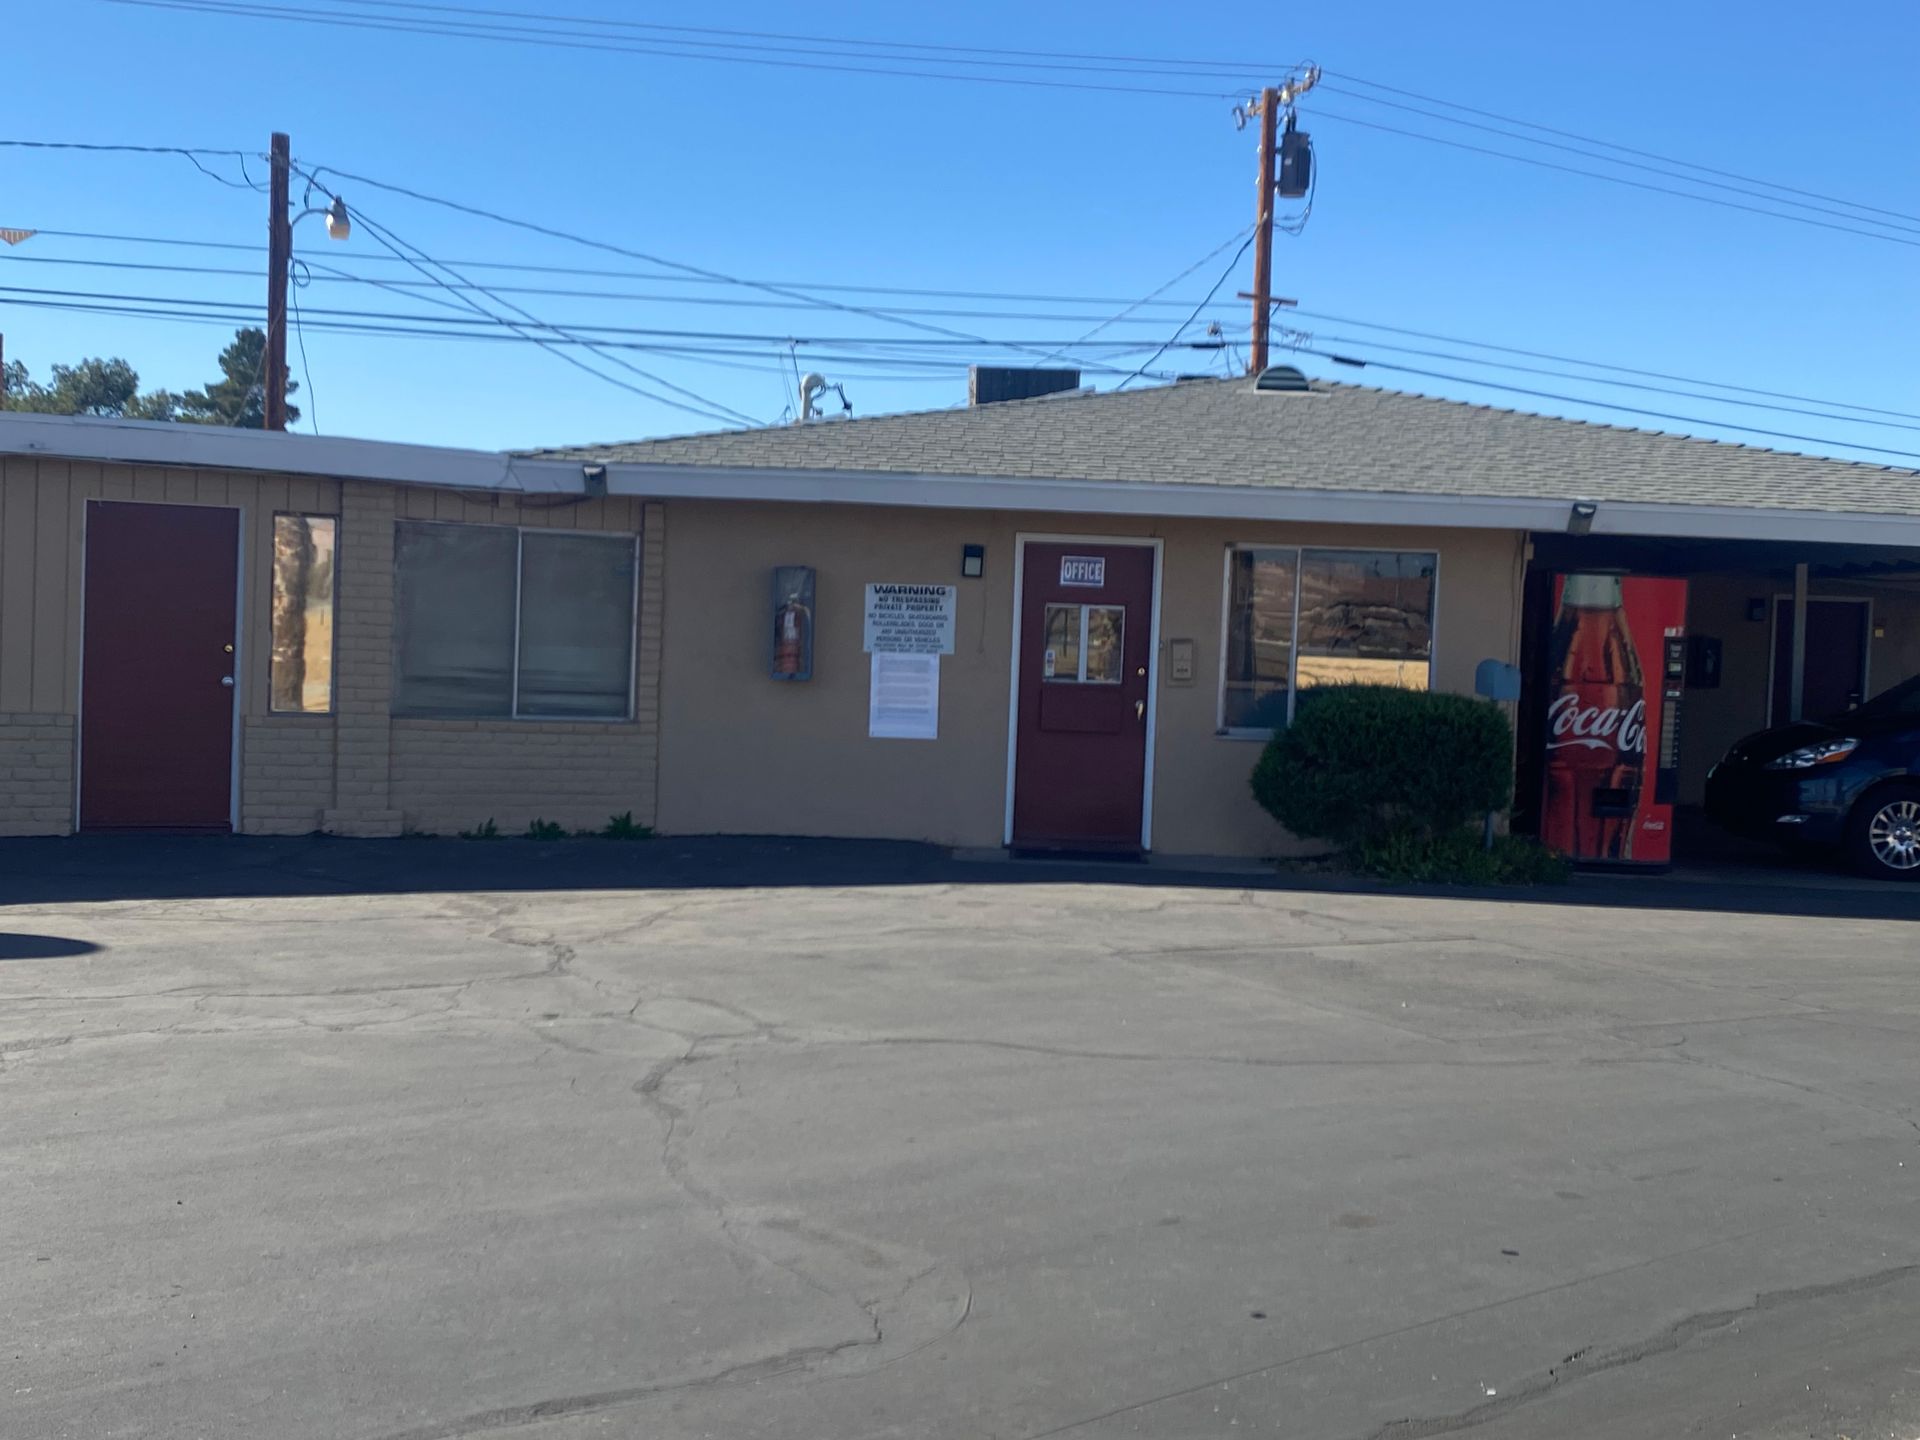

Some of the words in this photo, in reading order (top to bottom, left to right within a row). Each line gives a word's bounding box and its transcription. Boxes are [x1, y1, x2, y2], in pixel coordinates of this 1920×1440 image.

[1064, 562, 1101, 580] OFFICE
[874, 585, 946, 595] WARNING
[905, 604, 944, 612] PROPERTY
